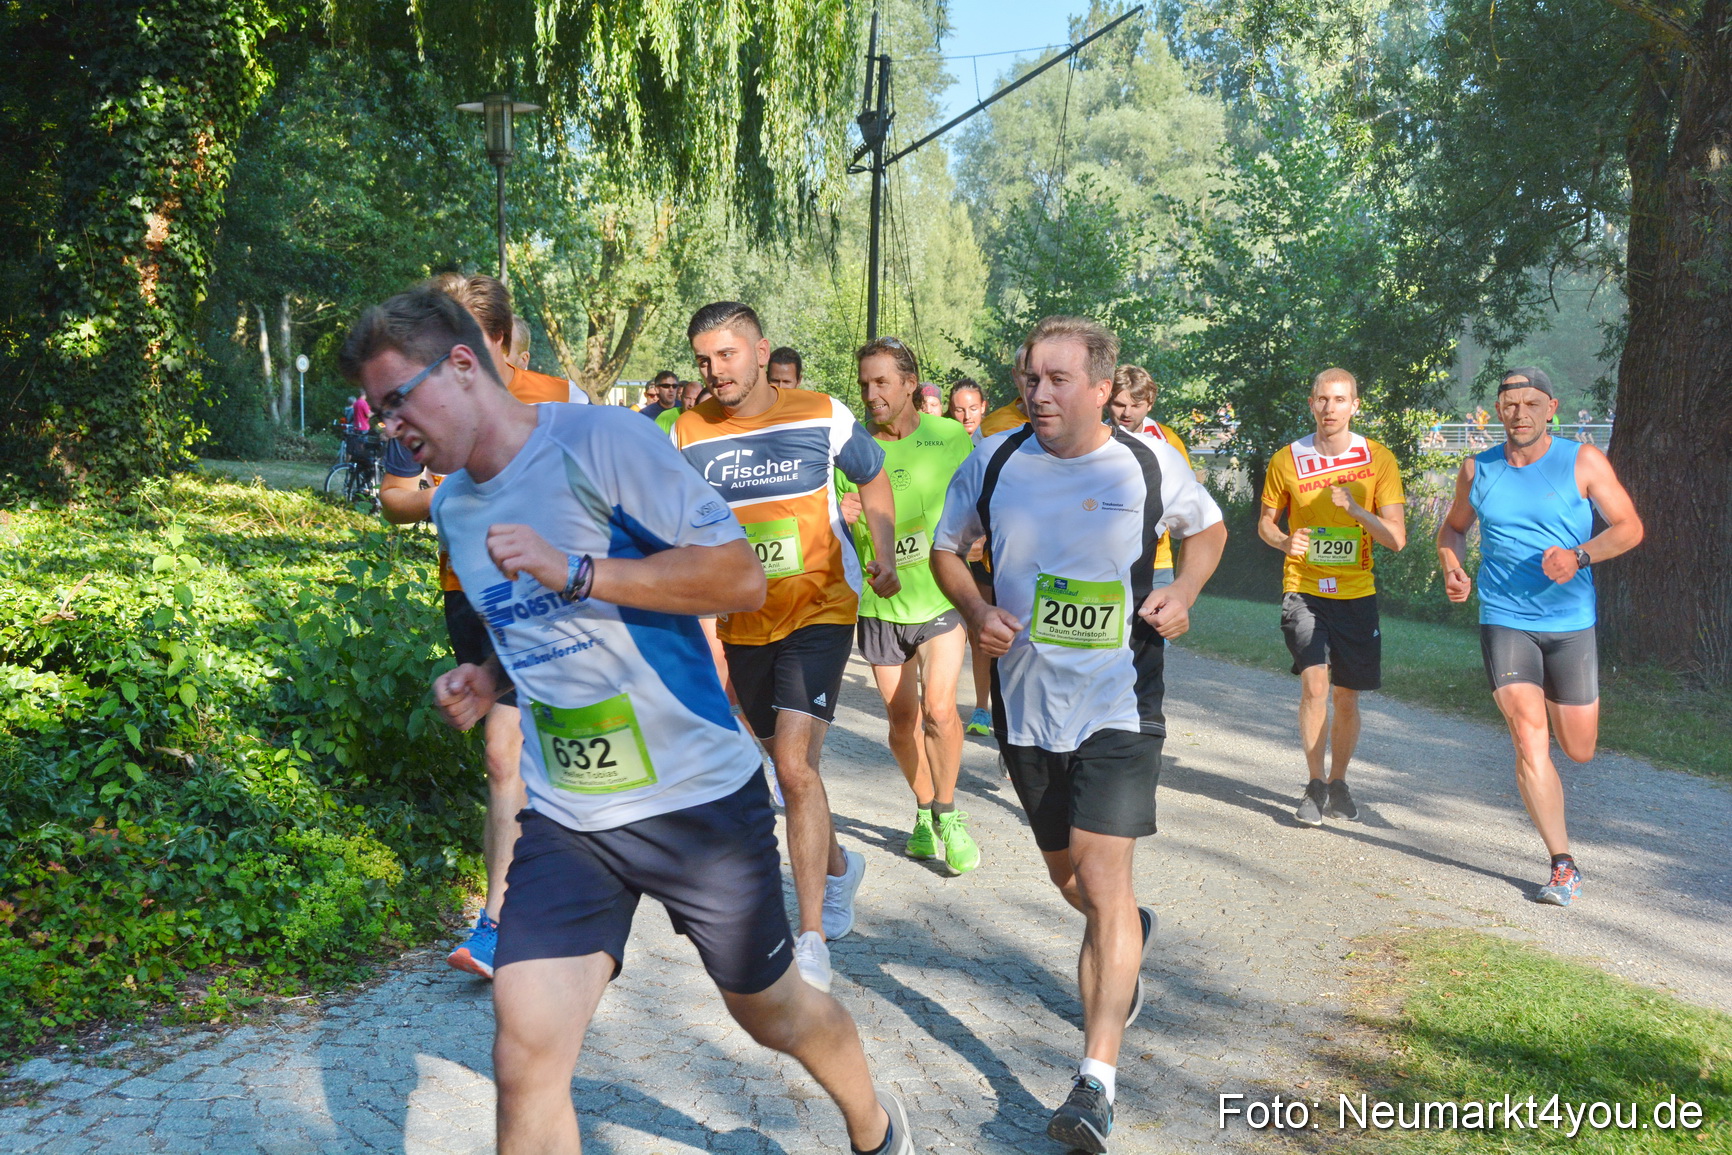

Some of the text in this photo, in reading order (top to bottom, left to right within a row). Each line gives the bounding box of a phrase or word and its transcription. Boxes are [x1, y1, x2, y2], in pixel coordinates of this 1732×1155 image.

[721, 458, 802, 482] Fischer
[730, 472, 799, 489] AUTOMOBILE
[1298, 468, 1375, 494] MAX BÖGL
[1313, 540, 1353, 555] 1290
[1043, 600, 1115, 630] 2007
[1049, 626, 1107, 639] Daum Christoph
[552, 736, 618, 770] 632
